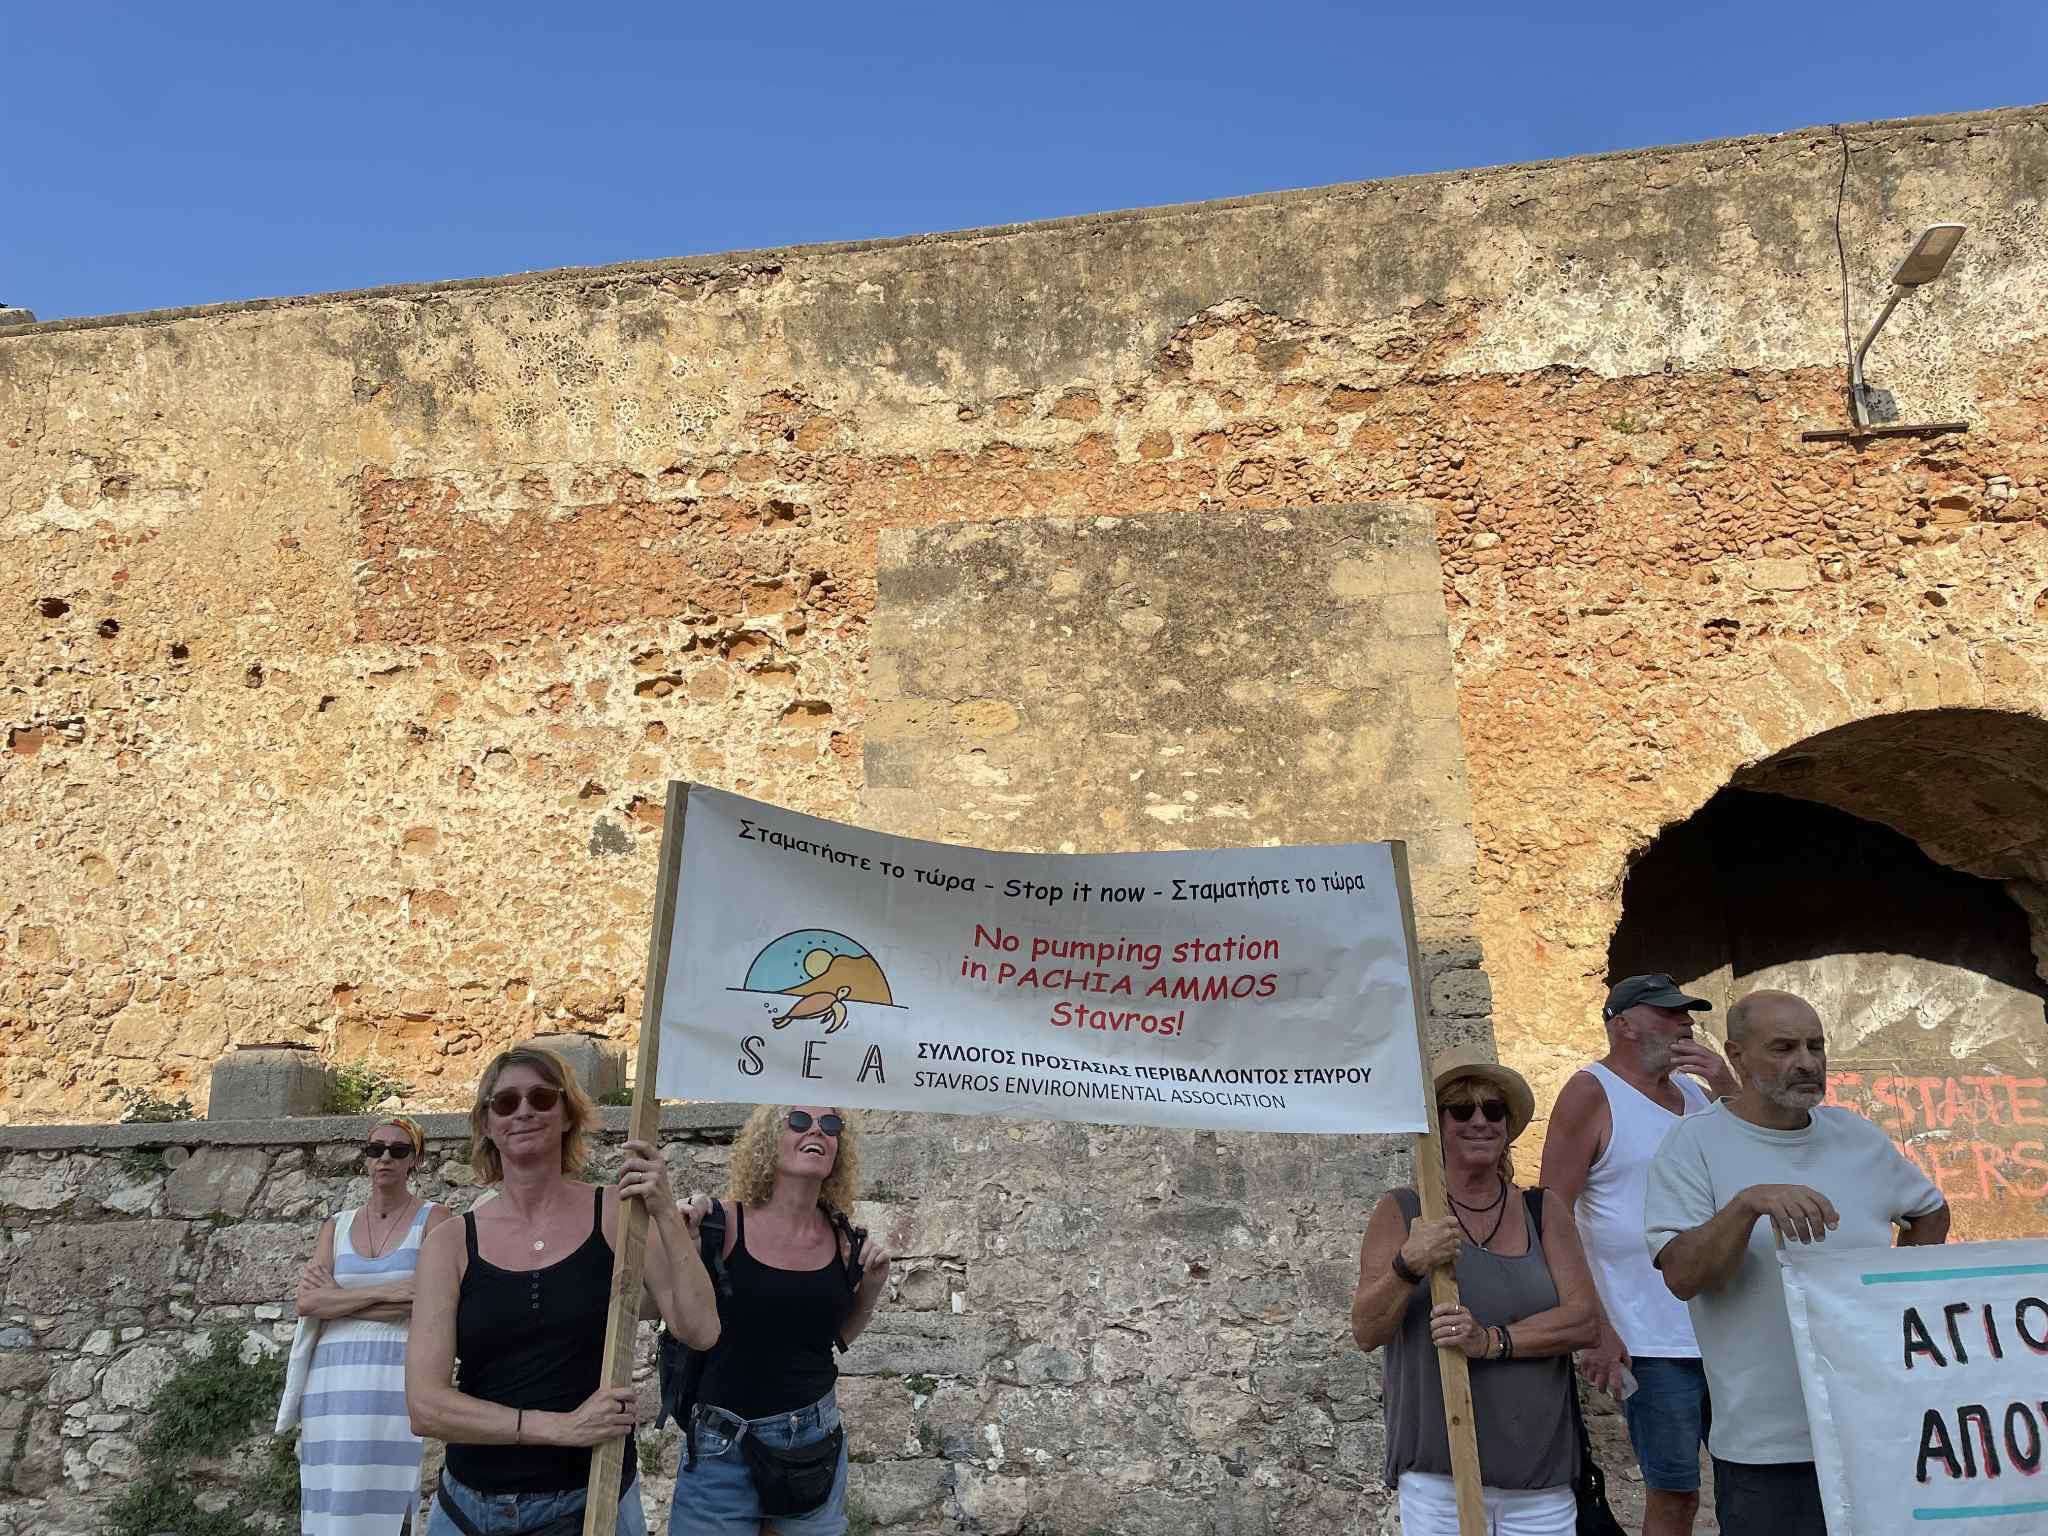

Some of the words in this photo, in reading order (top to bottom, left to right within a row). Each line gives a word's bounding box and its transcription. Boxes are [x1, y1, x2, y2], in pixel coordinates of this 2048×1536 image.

[738, 818, 871, 871] Σταματήστε
[879, 861, 905, 879] το
[913, 868, 976, 892] τώρα
[1003, 879, 1064, 907] Stop
[1072, 881, 1092, 903] it
[1100, 887, 1146, 903] now
[1171, 875, 1290, 904] Σταματήστε
[1294, 878, 1316, 894] το
[1320, 871, 1366, 895] τώρα
[974, 923, 1020, 952] No
[1032, 937, 1161, 970] pumping
[1171, 934, 1279, 964] station
[961, 955, 987, 982] in
[999, 963, 1131, 995] PACHIA
[1145, 973, 1278, 1002] AMMOS
[1050, 1001, 1185, 1037] Stavros!
[917, 1042, 1016, 1065] ΣΥΛΛΟΓΟΣ
[1021, 1052, 1132, 1077] ΠΡΟΣΤΑΣΙΑΣ
[1135, 1066, 1288, 1085] ΠΕΡΙΒΑΛΛΟΝΤΟΣ
[1293, 1067, 1372, 1084] ΣΤΑΥΡΟΥ
[913, 1071, 999, 1093] STAVROS
[1006, 1076, 1168, 1102] ENVIRONMENTAL
[1171, 1089, 1286, 1109] ASSOCIATION
[1916, 1400, 2048, 1484] ΑΠΟ
